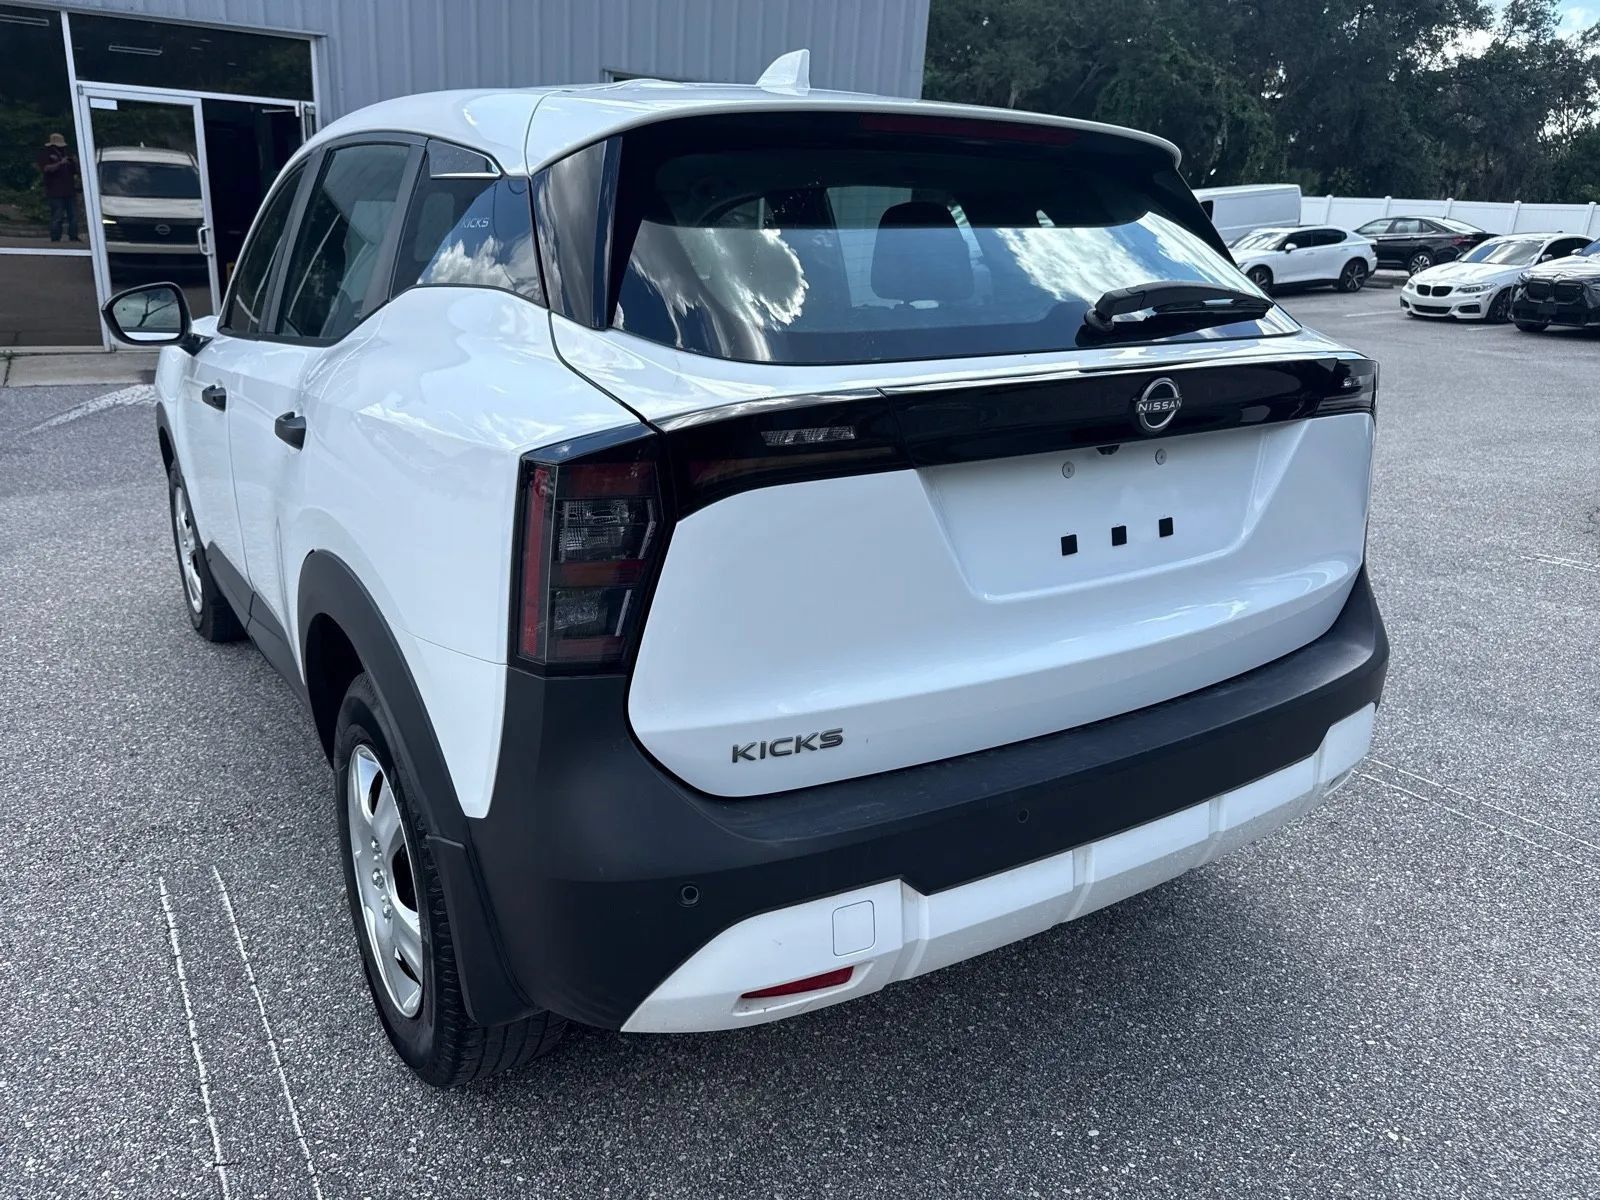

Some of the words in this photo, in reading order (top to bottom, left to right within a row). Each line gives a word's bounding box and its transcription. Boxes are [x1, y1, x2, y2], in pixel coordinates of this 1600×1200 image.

[462, 217, 490, 229] KICKS
[1138, 400, 1181, 412] NISSAN
[731, 727, 844, 764] KICKS
